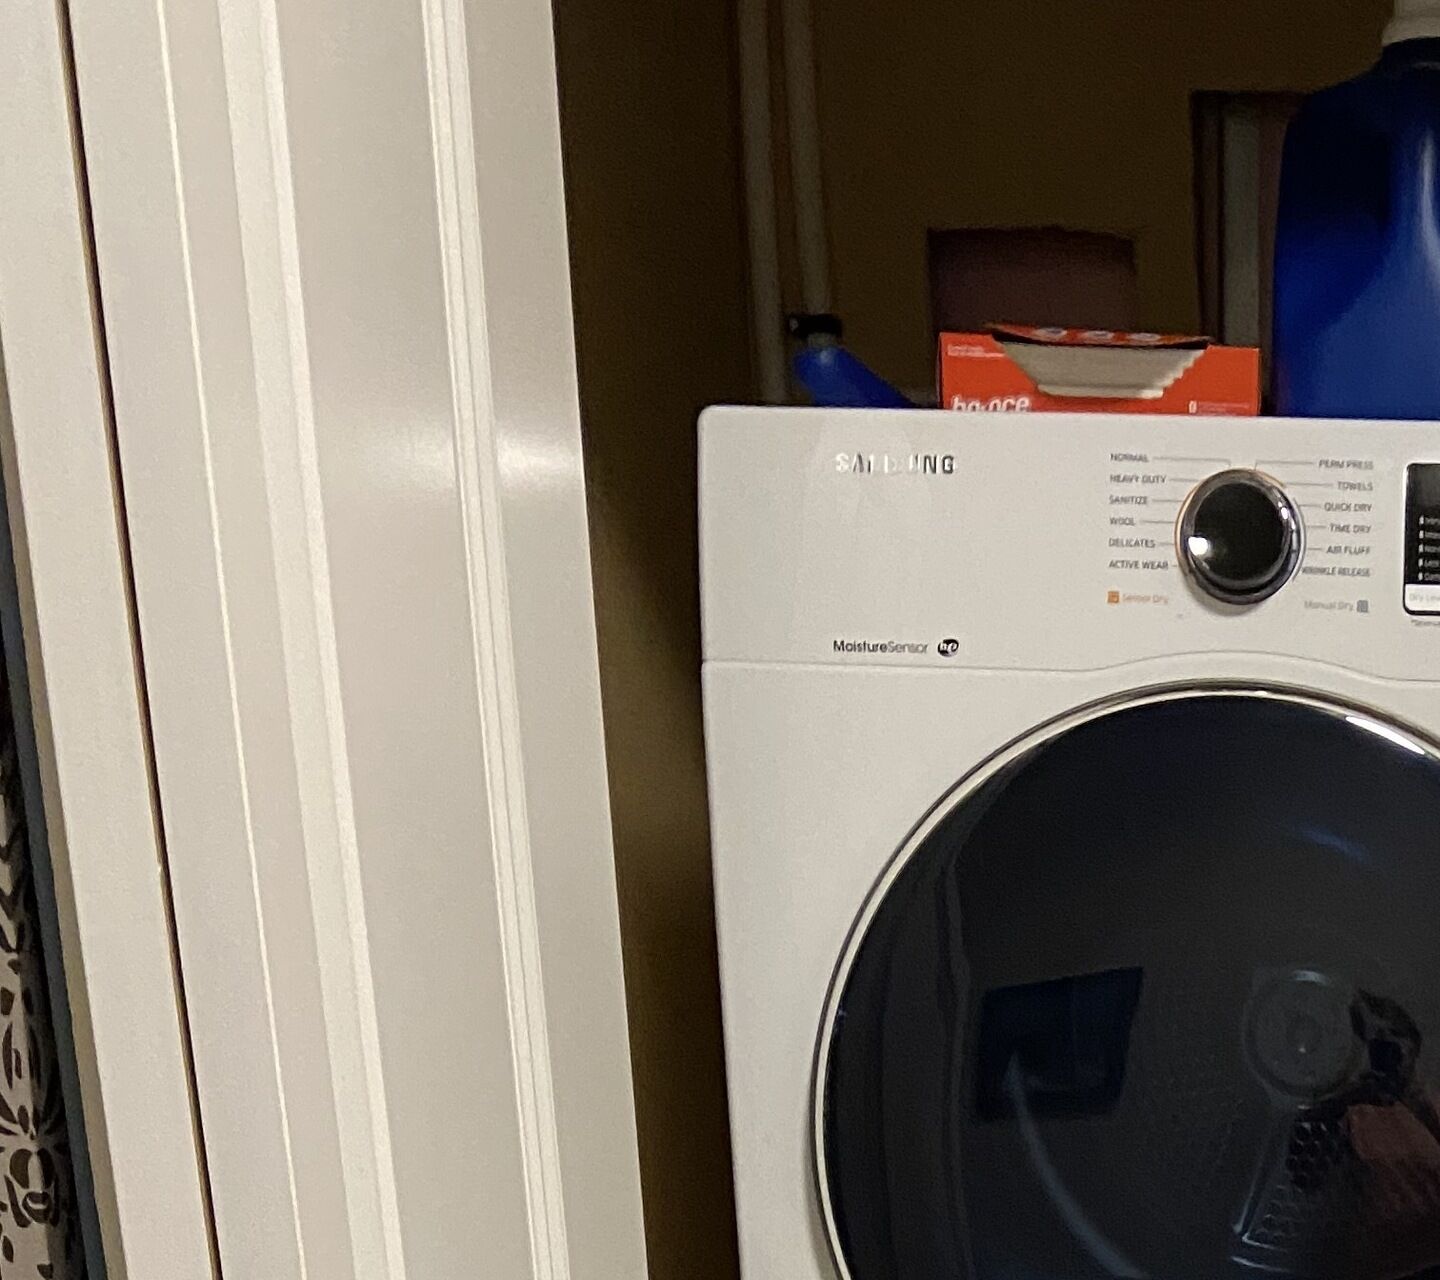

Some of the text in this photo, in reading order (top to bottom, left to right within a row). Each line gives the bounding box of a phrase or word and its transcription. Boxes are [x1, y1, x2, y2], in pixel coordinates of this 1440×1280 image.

[1111, 453, 1148, 462] NORMAL
[835, 452, 955, 474] SAUNG
[1319, 460, 1373, 470] PERM PRESS
[1110, 474, 1166, 484] HEAVY DUTY
[1337, 481, 1373, 491] TOWELS
[1109, 495, 1148, 505] SANITIZE
[1324, 502, 1372, 512] QUICK DRY
[1110, 517, 1136, 526] WOOL
[1330, 523, 1371, 533] TIME DRY
[1109, 538, 1155, 548] DELICATES
[1326, 545, 1370, 555] AIR FLUFF
[1109, 560, 1168, 570] ACTIVE WEAR
[1338, 567, 1370, 577] RELEASE
[833, 640, 928, 654] MoistureSensor
